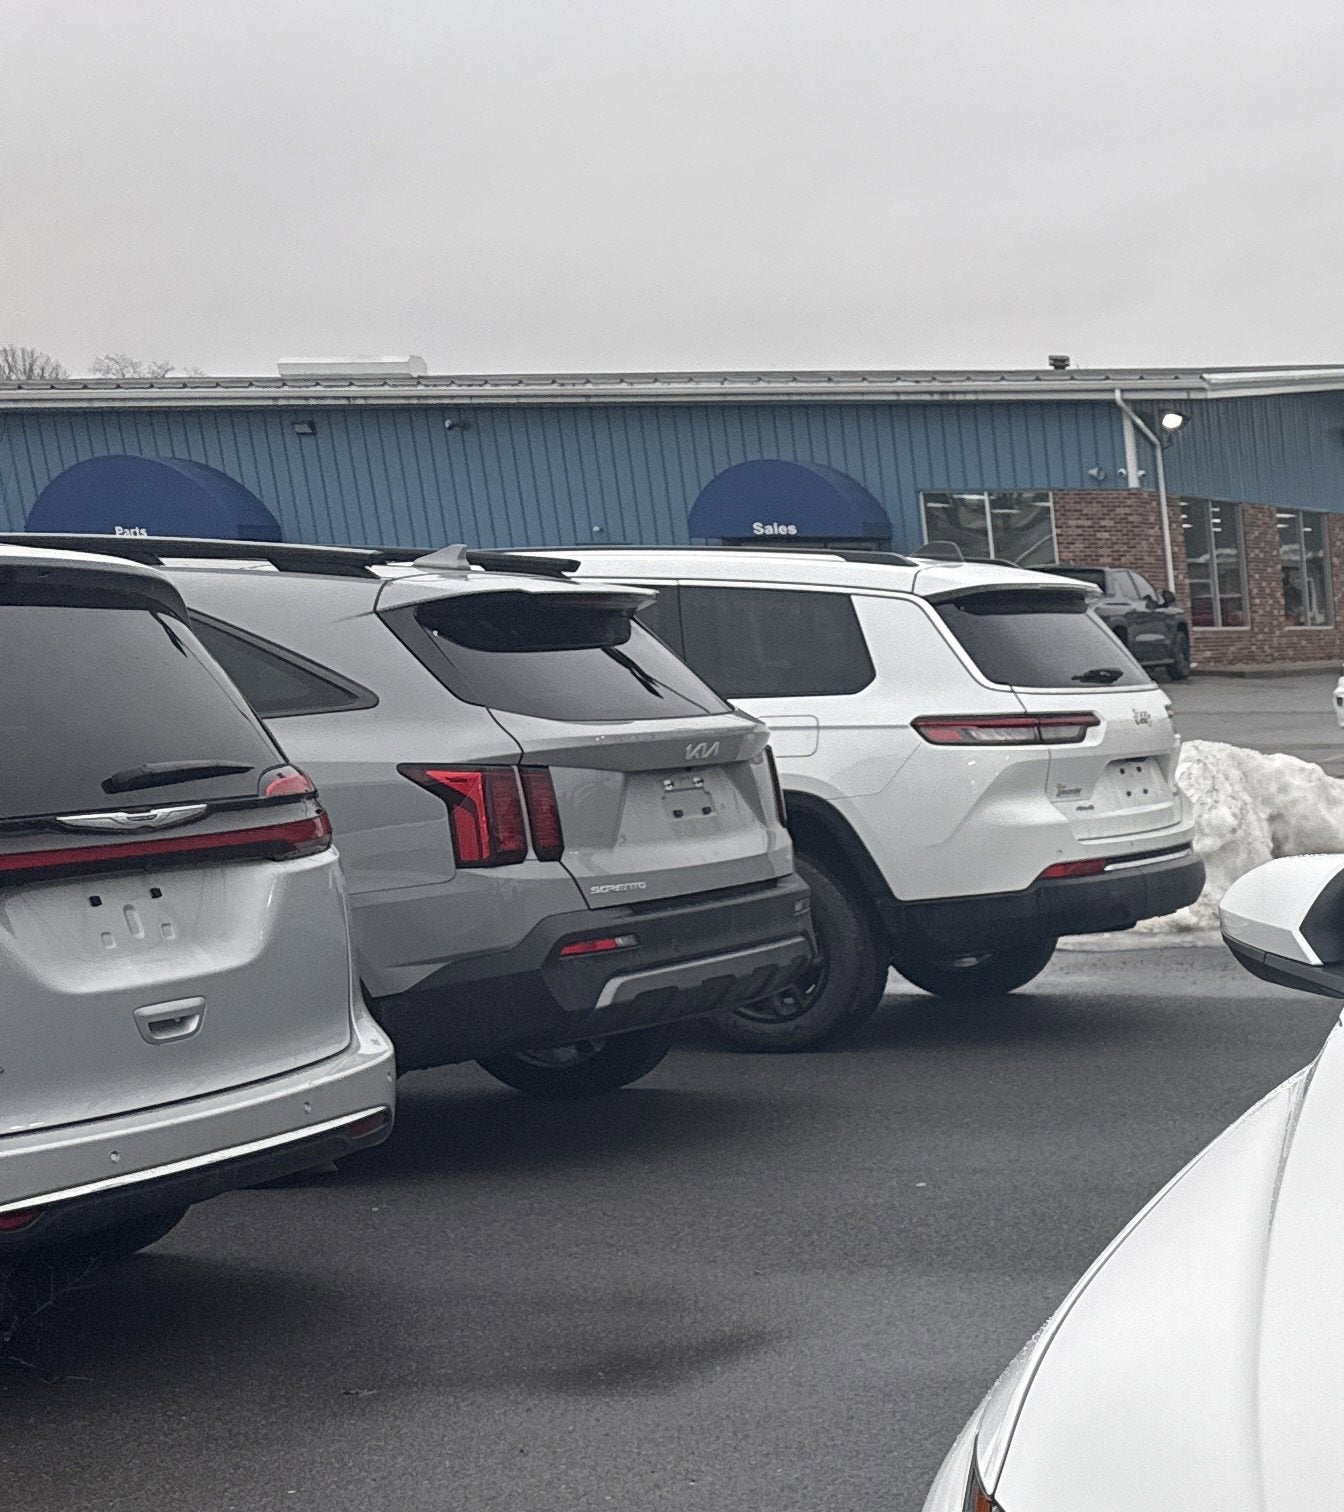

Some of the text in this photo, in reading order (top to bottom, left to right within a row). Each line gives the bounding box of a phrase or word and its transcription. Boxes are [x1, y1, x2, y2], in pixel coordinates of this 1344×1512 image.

[114, 525, 147, 537] Parts
[752, 521, 797, 535] Sales
[590, 881, 646, 895] SORENTO
